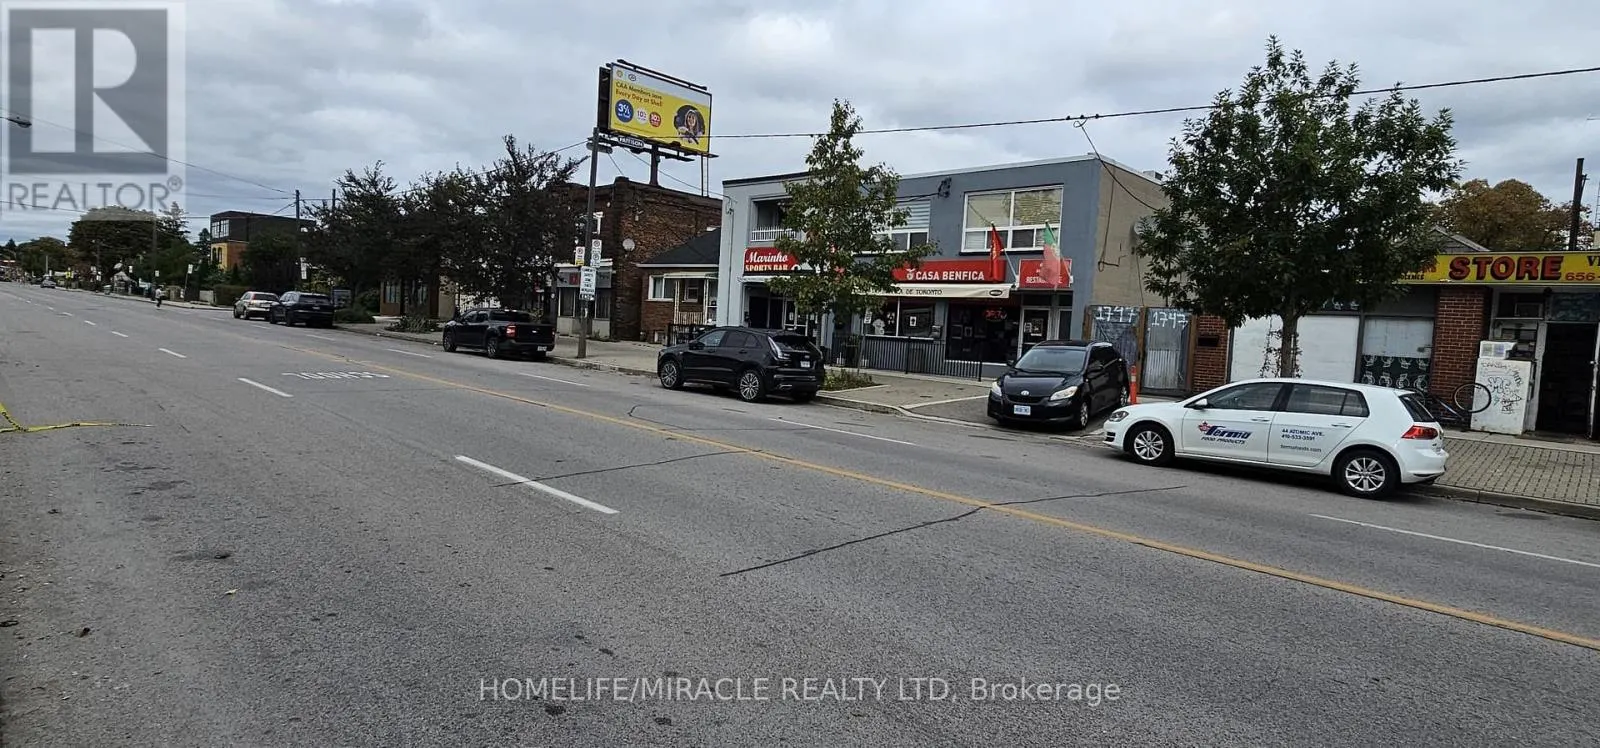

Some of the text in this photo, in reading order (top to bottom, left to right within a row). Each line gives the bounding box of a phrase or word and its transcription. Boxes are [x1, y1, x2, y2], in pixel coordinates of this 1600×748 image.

[616, 89, 631, 98] Every
[632, 93, 643, 102] Day
[745, 251, 788, 263] Marinho
[745, 264, 772, 272] SPORTS
[1449, 255, 1565, 281] STORE
[915, 271, 985, 281] CASA BENFICA
[1095, 306, 1136, 323] 1747
[1152, 311, 1188, 328] 1747
